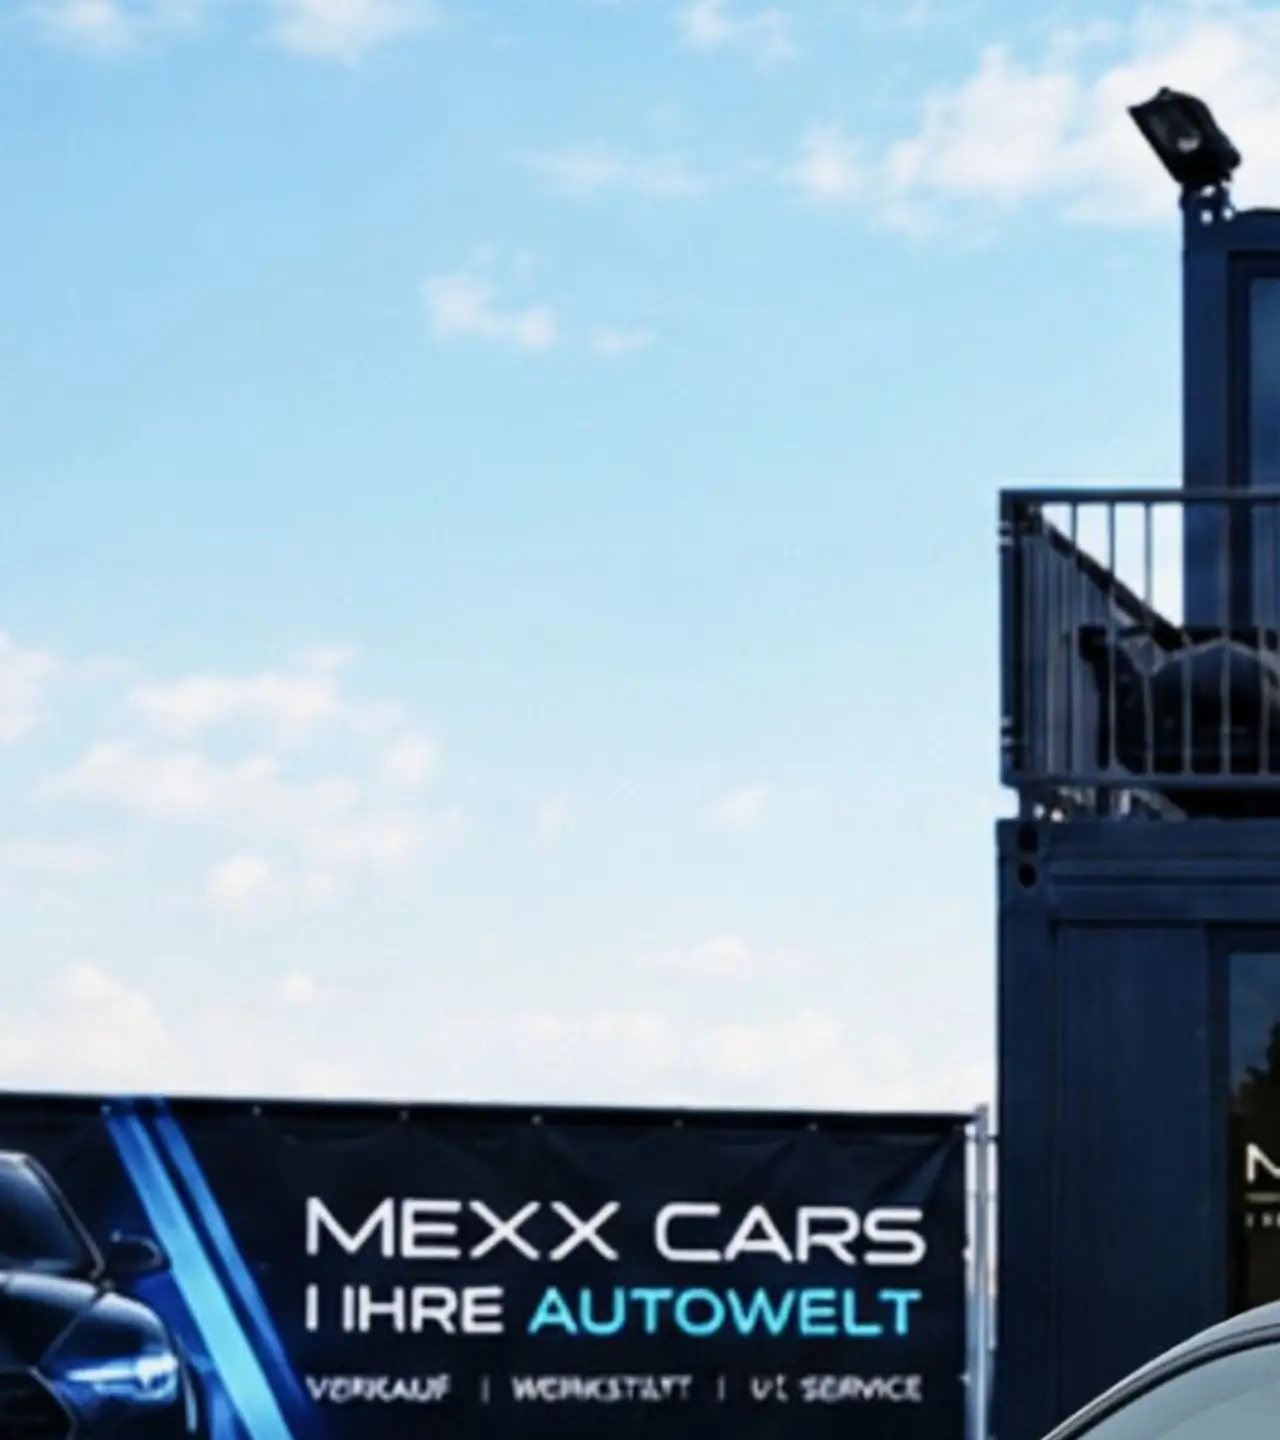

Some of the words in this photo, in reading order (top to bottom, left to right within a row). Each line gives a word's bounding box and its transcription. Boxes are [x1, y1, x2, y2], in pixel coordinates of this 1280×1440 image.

[305, 1197, 620, 1261] MEXX
[654, 1203, 927, 1265] CARS
[343, 1285, 503, 1333] IHRE
[528, 1287, 922, 1336] AUTOWELT
